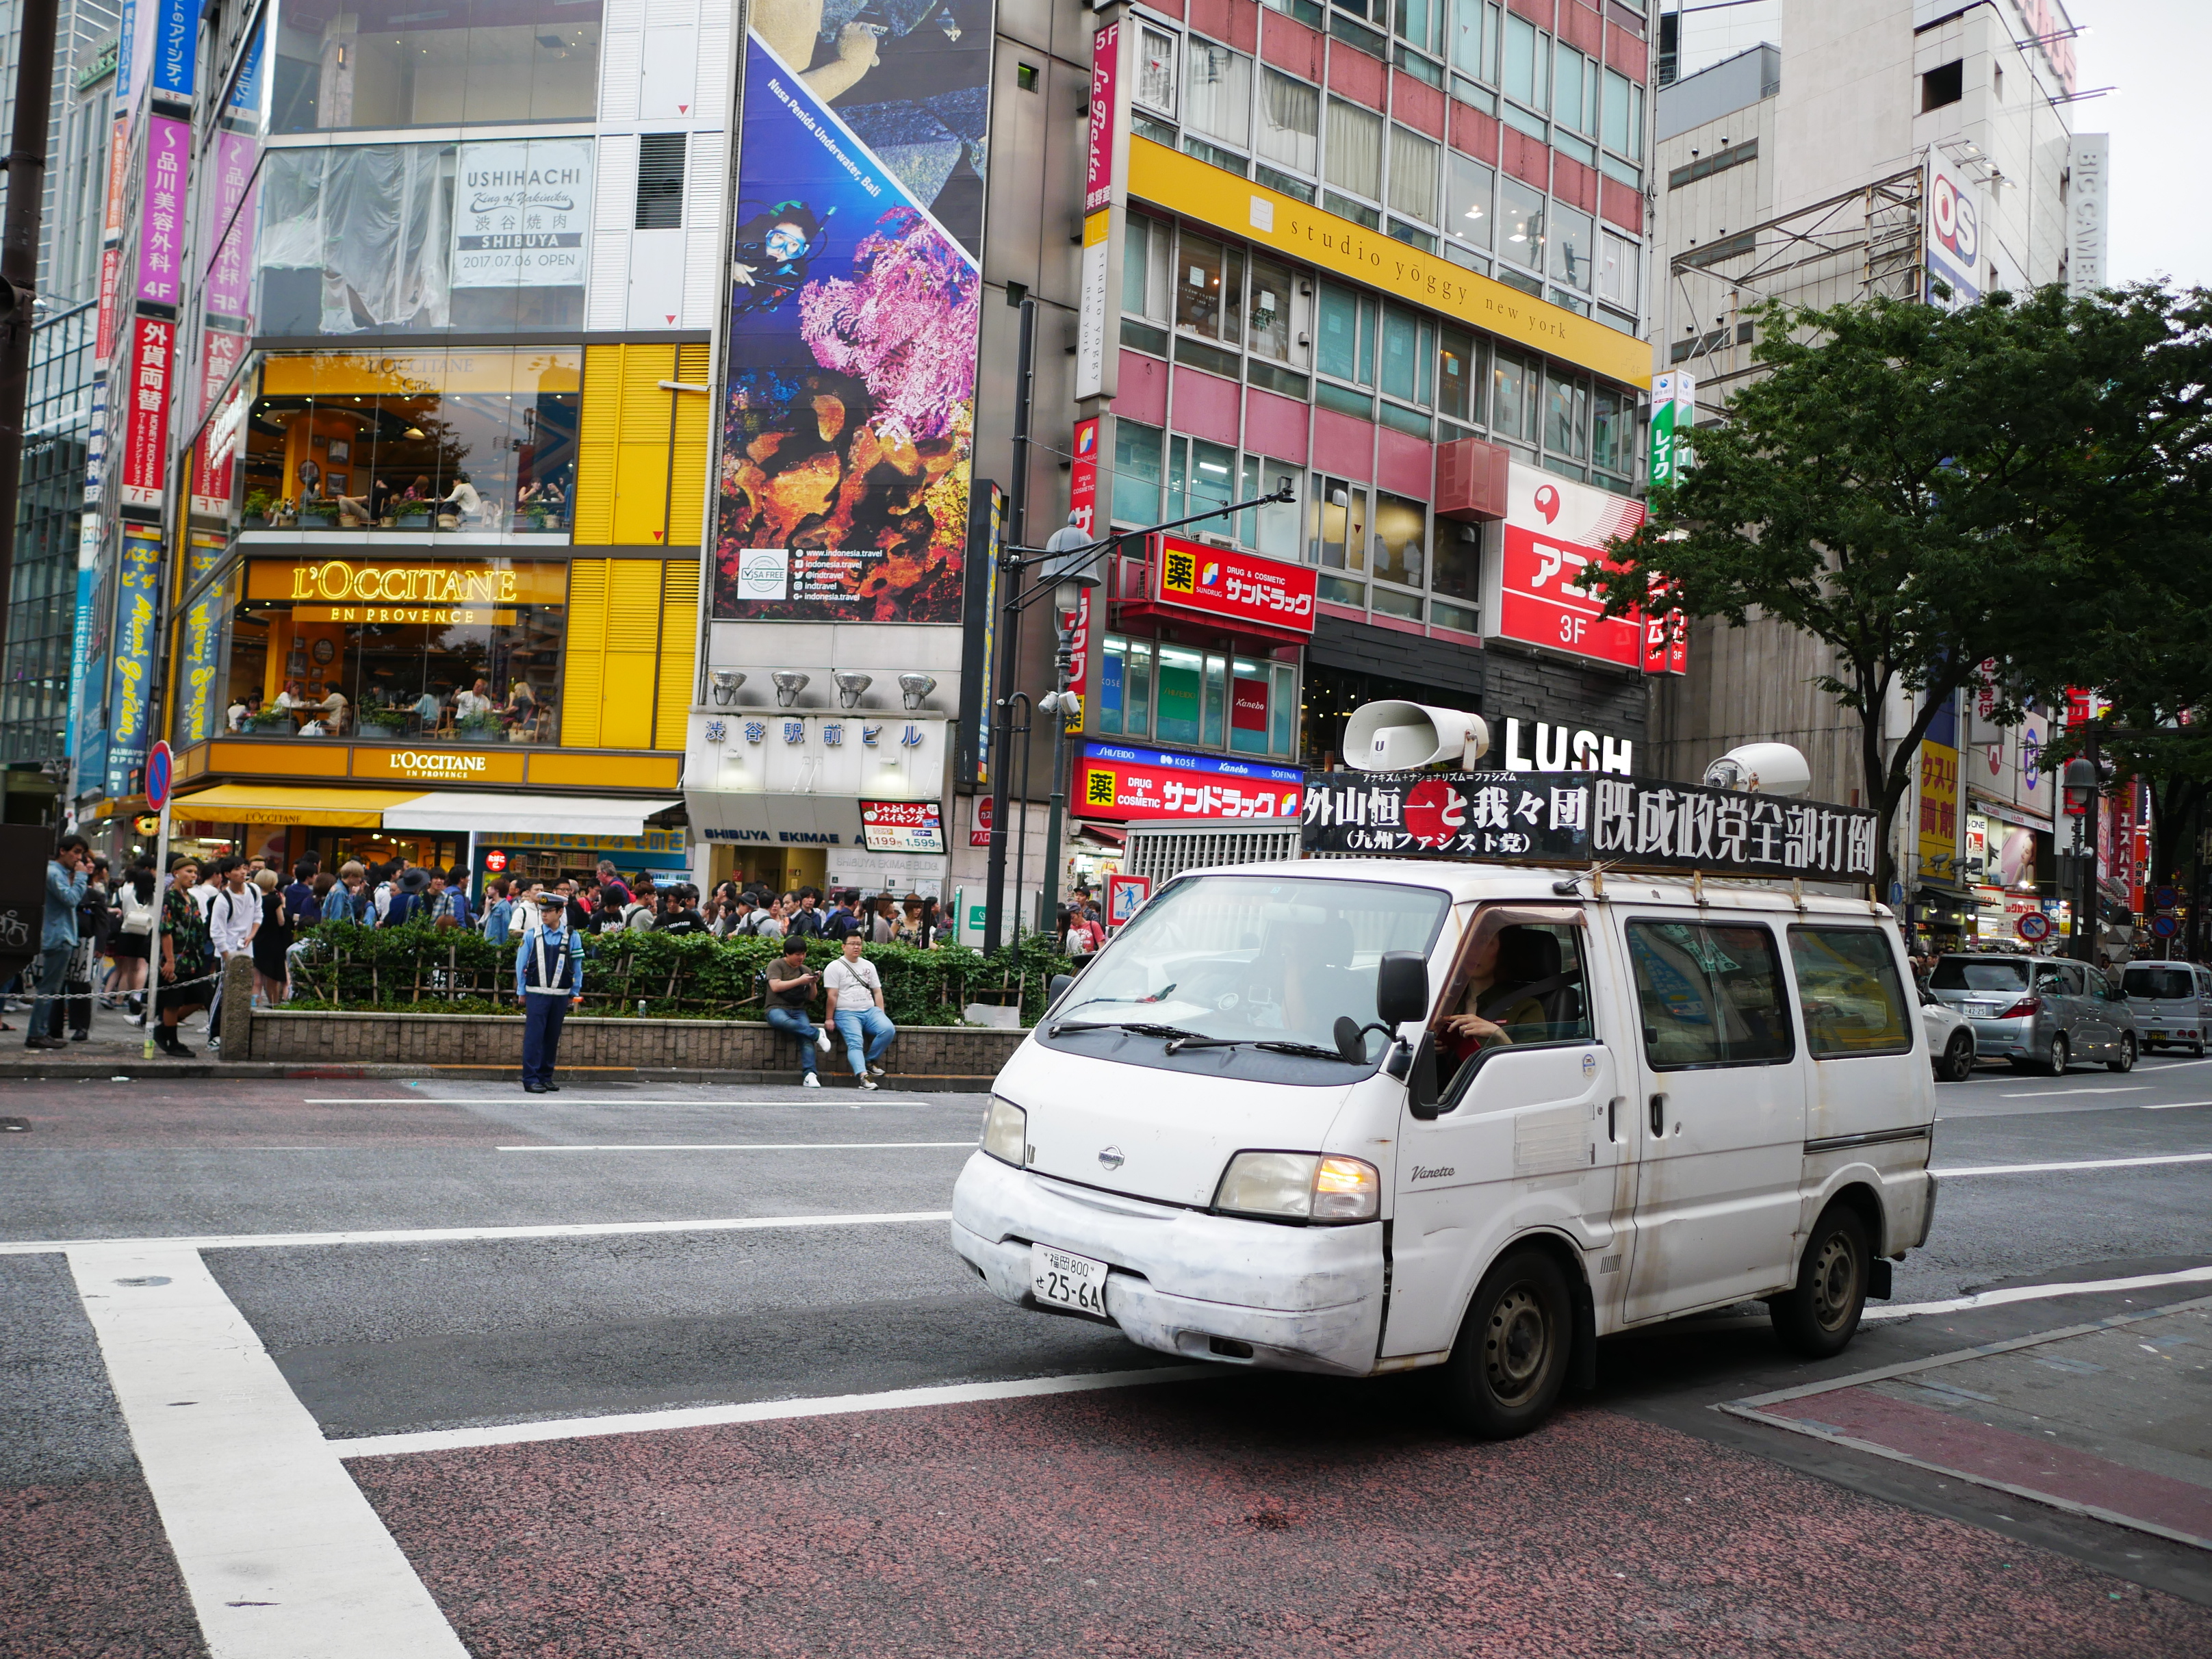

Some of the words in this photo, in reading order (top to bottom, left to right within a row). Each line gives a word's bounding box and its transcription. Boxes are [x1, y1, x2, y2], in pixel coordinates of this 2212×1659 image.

[166, 0, 185, 86] トのアイシティ
[1095, 23, 1118, 51] 5F
[165, 91, 181, 102] 5F
[767, 78, 790, 103] Nusa
[787, 99, 816, 131] Penida
[814, 126, 862, 181] Underwater,
[860, 175, 882, 198] Bali
[467, 168, 580, 188] USHIHACHI
[2077, 149, 2100, 193] BIC
[474, 192, 500, 204] King
[503, 192, 515, 205] of
[516, 190, 570, 205] Yakiniku
[149, 151, 178, 274] 品川美容外科
[1934, 178, 1975, 256] OS
[475, 214, 567, 231] 渋谷焼肉
[481, 233, 559, 248] SHIBUYA
[2076, 197, 2099, 293] CAMER
[463, 254, 531, 268] 2017.07.06
[538, 254, 576, 266] OPEN
[1096, 253, 1104, 316] studio
[1291, 219, 1380, 266] studio
[1486, 298, 1518, 320] new
[1529, 316, 1567, 340] york
[143, 281, 171, 298] 4F
[138, 322, 168, 412] 外貨両替
[402, 376, 437, 391] Café
[148, 414, 159, 442] MONEY
[1074, 452, 1097, 465] SUNDRUG
[1653, 429, 1671, 479] レイク
[144, 444, 156, 487] EXCHANGE
[1078, 474, 1091, 483] DRUG
[130, 487, 154, 502] 7F
[1072, 484, 1094, 495] COSMETIC
[124, 546, 159, 563] パスタ
[806, 549, 883, 558] www.indonesia.travel
[805, 560, 862, 569] indonesia.travel
[1166, 554, 1193, 590] 薬
[122, 571, 157, 589] ピザ
[805, 571, 844, 580] @indtravel
[1226, 565, 1244, 576] DRUG
[1247, 570, 1252, 578] &
[1255, 572, 1286, 585] COSMETIC
[804, 582, 837, 591] indtravel
[1196, 586, 1222, 597] SUNDRUG
[804, 592, 860, 601] indonesia.travel
[1226, 577, 1312, 616] サンドラッグ
[331, 608, 355, 620] EN
[366, 608, 474, 623] PROVENCE
[1560, 614, 1587, 643] 3F
[1673, 650, 1682, 660] 3F
[1101, 678, 1120, 687] KOSÉ
[1163, 687, 1196, 699] SHISEIDO
[1235, 698, 1264, 710] Kanebo
[705, 720, 925, 746] 渋谷駅前ビル
[1505, 717, 1632, 775] LUSH
[110, 756, 143, 765] OPEN
[1096, 747, 1135, 760] SHISEIDO
[1174, 757, 1196, 767] KOSÉ
[1218, 762, 1248, 774] Kanebo
[1271, 769, 1296, 780] SOFINA
[422, 770, 468, 779] PROVENCE
[1922, 751, 1955, 794] クスリ
[1090, 773, 1112, 803] 薬
[1128, 777, 1153, 788] DRUG
[1117, 794, 1161, 808] COSMETIC
[1136, 788, 1144, 797] &
[1163, 781, 1276, 818] サンドラッグ
[873, 803, 926, 814] しゃぶしゃぶ
[1302, 785, 1589, 831] 外山恒一と我々団
[879, 813, 924, 824] バイキング
[1920, 795, 1955, 840] 調剤
[1593, 778, 1878, 876] 既成政党全部打倒
[704, 828, 771, 841] SHIBUYA
[778, 830, 839, 844] EKIMAE
[978, 834, 990, 843] 入口
[836, 858, 876, 868] SHIBUYA
[878, 858, 912, 869] EKIMAE
[914, 860, 939, 871] BLDG.
[1101, 1153, 1120, 1162] NISSAN
[1411, 1165, 1456, 1182] Vanette
[1050, 1253, 1070, 1272] 福岡
[1070, 1259, 1089, 1277] 800
[1036, 1275, 1044, 1289] せ
